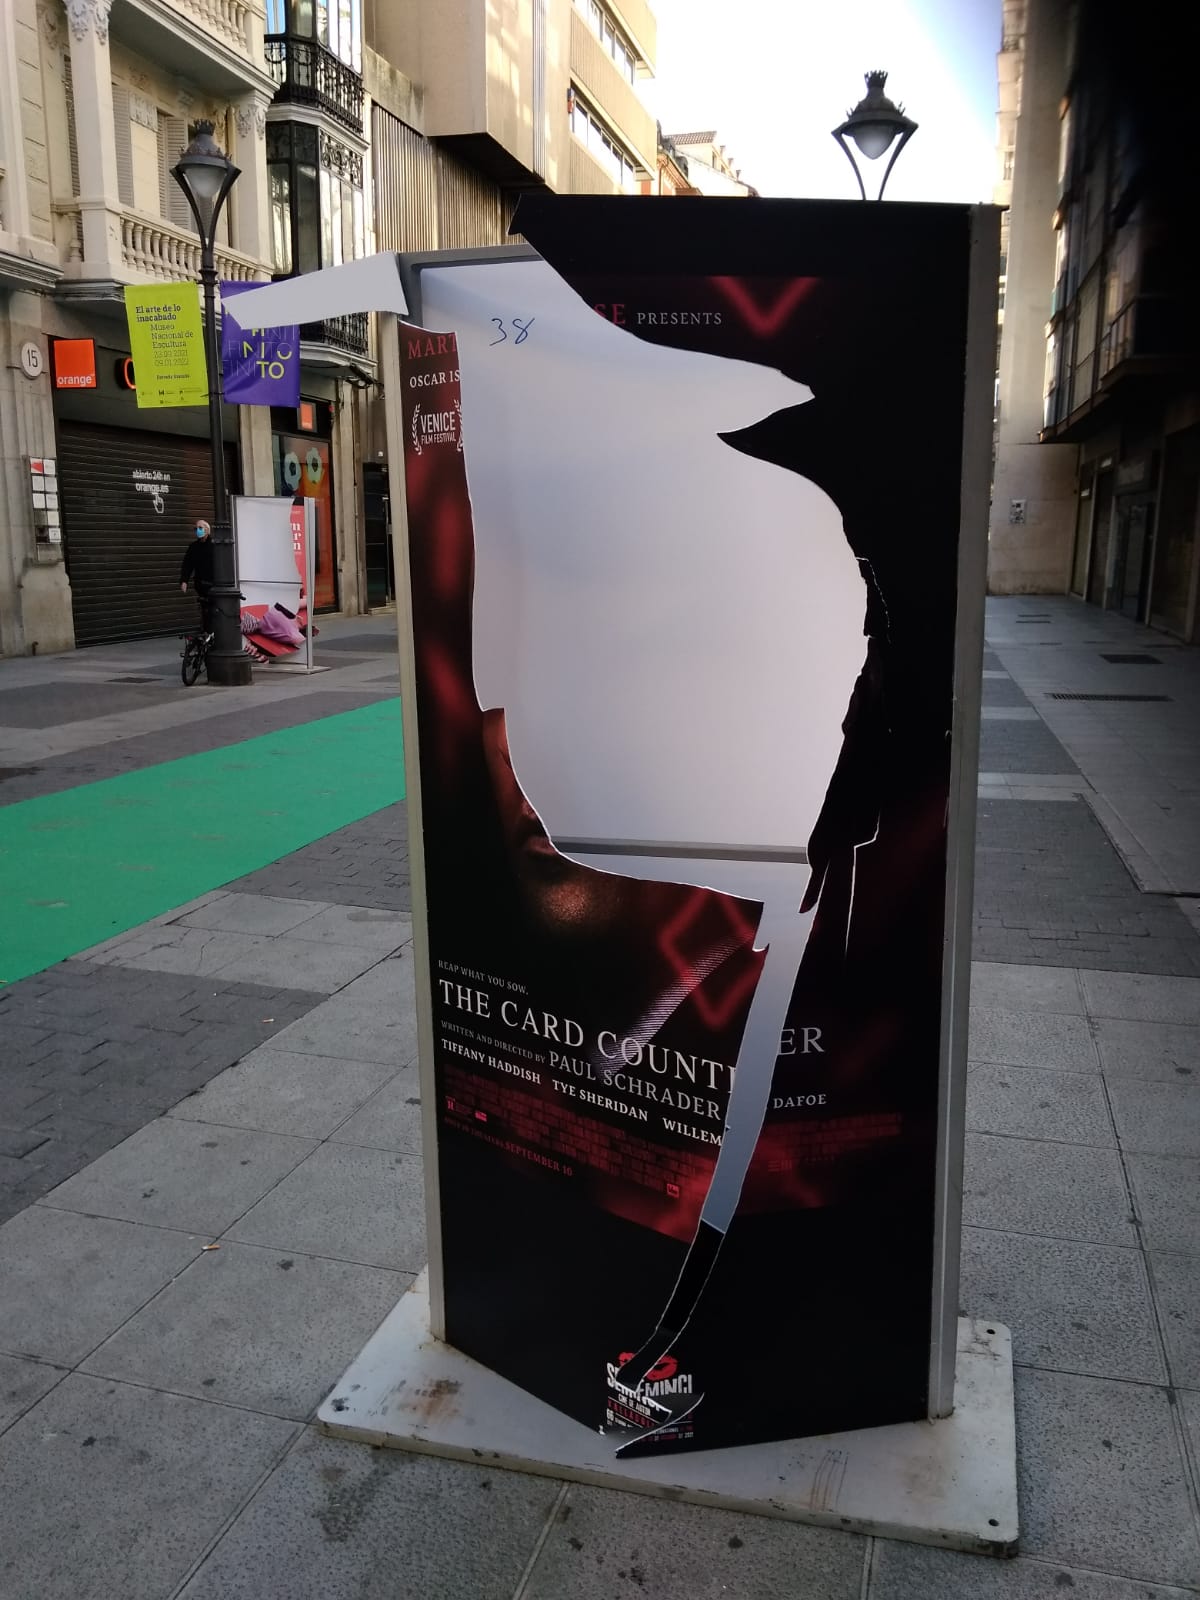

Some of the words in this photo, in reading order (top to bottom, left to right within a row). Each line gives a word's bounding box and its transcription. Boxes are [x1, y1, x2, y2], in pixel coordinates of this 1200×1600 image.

[162, 304, 172, 312] de
[173, 304, 182, 312] lo
[636, 312, 722, 326] PRESENTS
[489, 317, 536, 347] 38
[26, 348, 39, 368] 15
[57, 375, 93, 387] orange
[409, 371, 447, 389] OSCAR
[420, 411, 456, 434] VENICE
[420, 434, 434, 445] FILM
[433, 432, 457, 443] FESTIVAL
[438, 959, 459, 974] REAP
[460, 967, 486, 982] WHAT
[487, 974, 505, 988] YOU
[438, 978, 491, 1019] THE
[500, 1000, 584, 1047] CARD
[440, 1019, 475, 1039] WRITTEN
[476, 1033, 493, 1046] AND
[494, 1039, 534, 1060] DIRECTED
[534, 1054, 547, 1065] BY
[549, 1050, 597, 1081] PAUL
[603, 1069, 722, 1121] SCHRADER
[440, 1038, 487, 1063] TIFFANY
[487, 1056, 543, 1085] HADDISH
[551, 1079, 577, 1097] TYE
[579, 1089, 649, 1122] SHERIDAN
[662, 1117, 723, 1147] WILLEM
[773, 1093, 828, 1109] DAFOE
